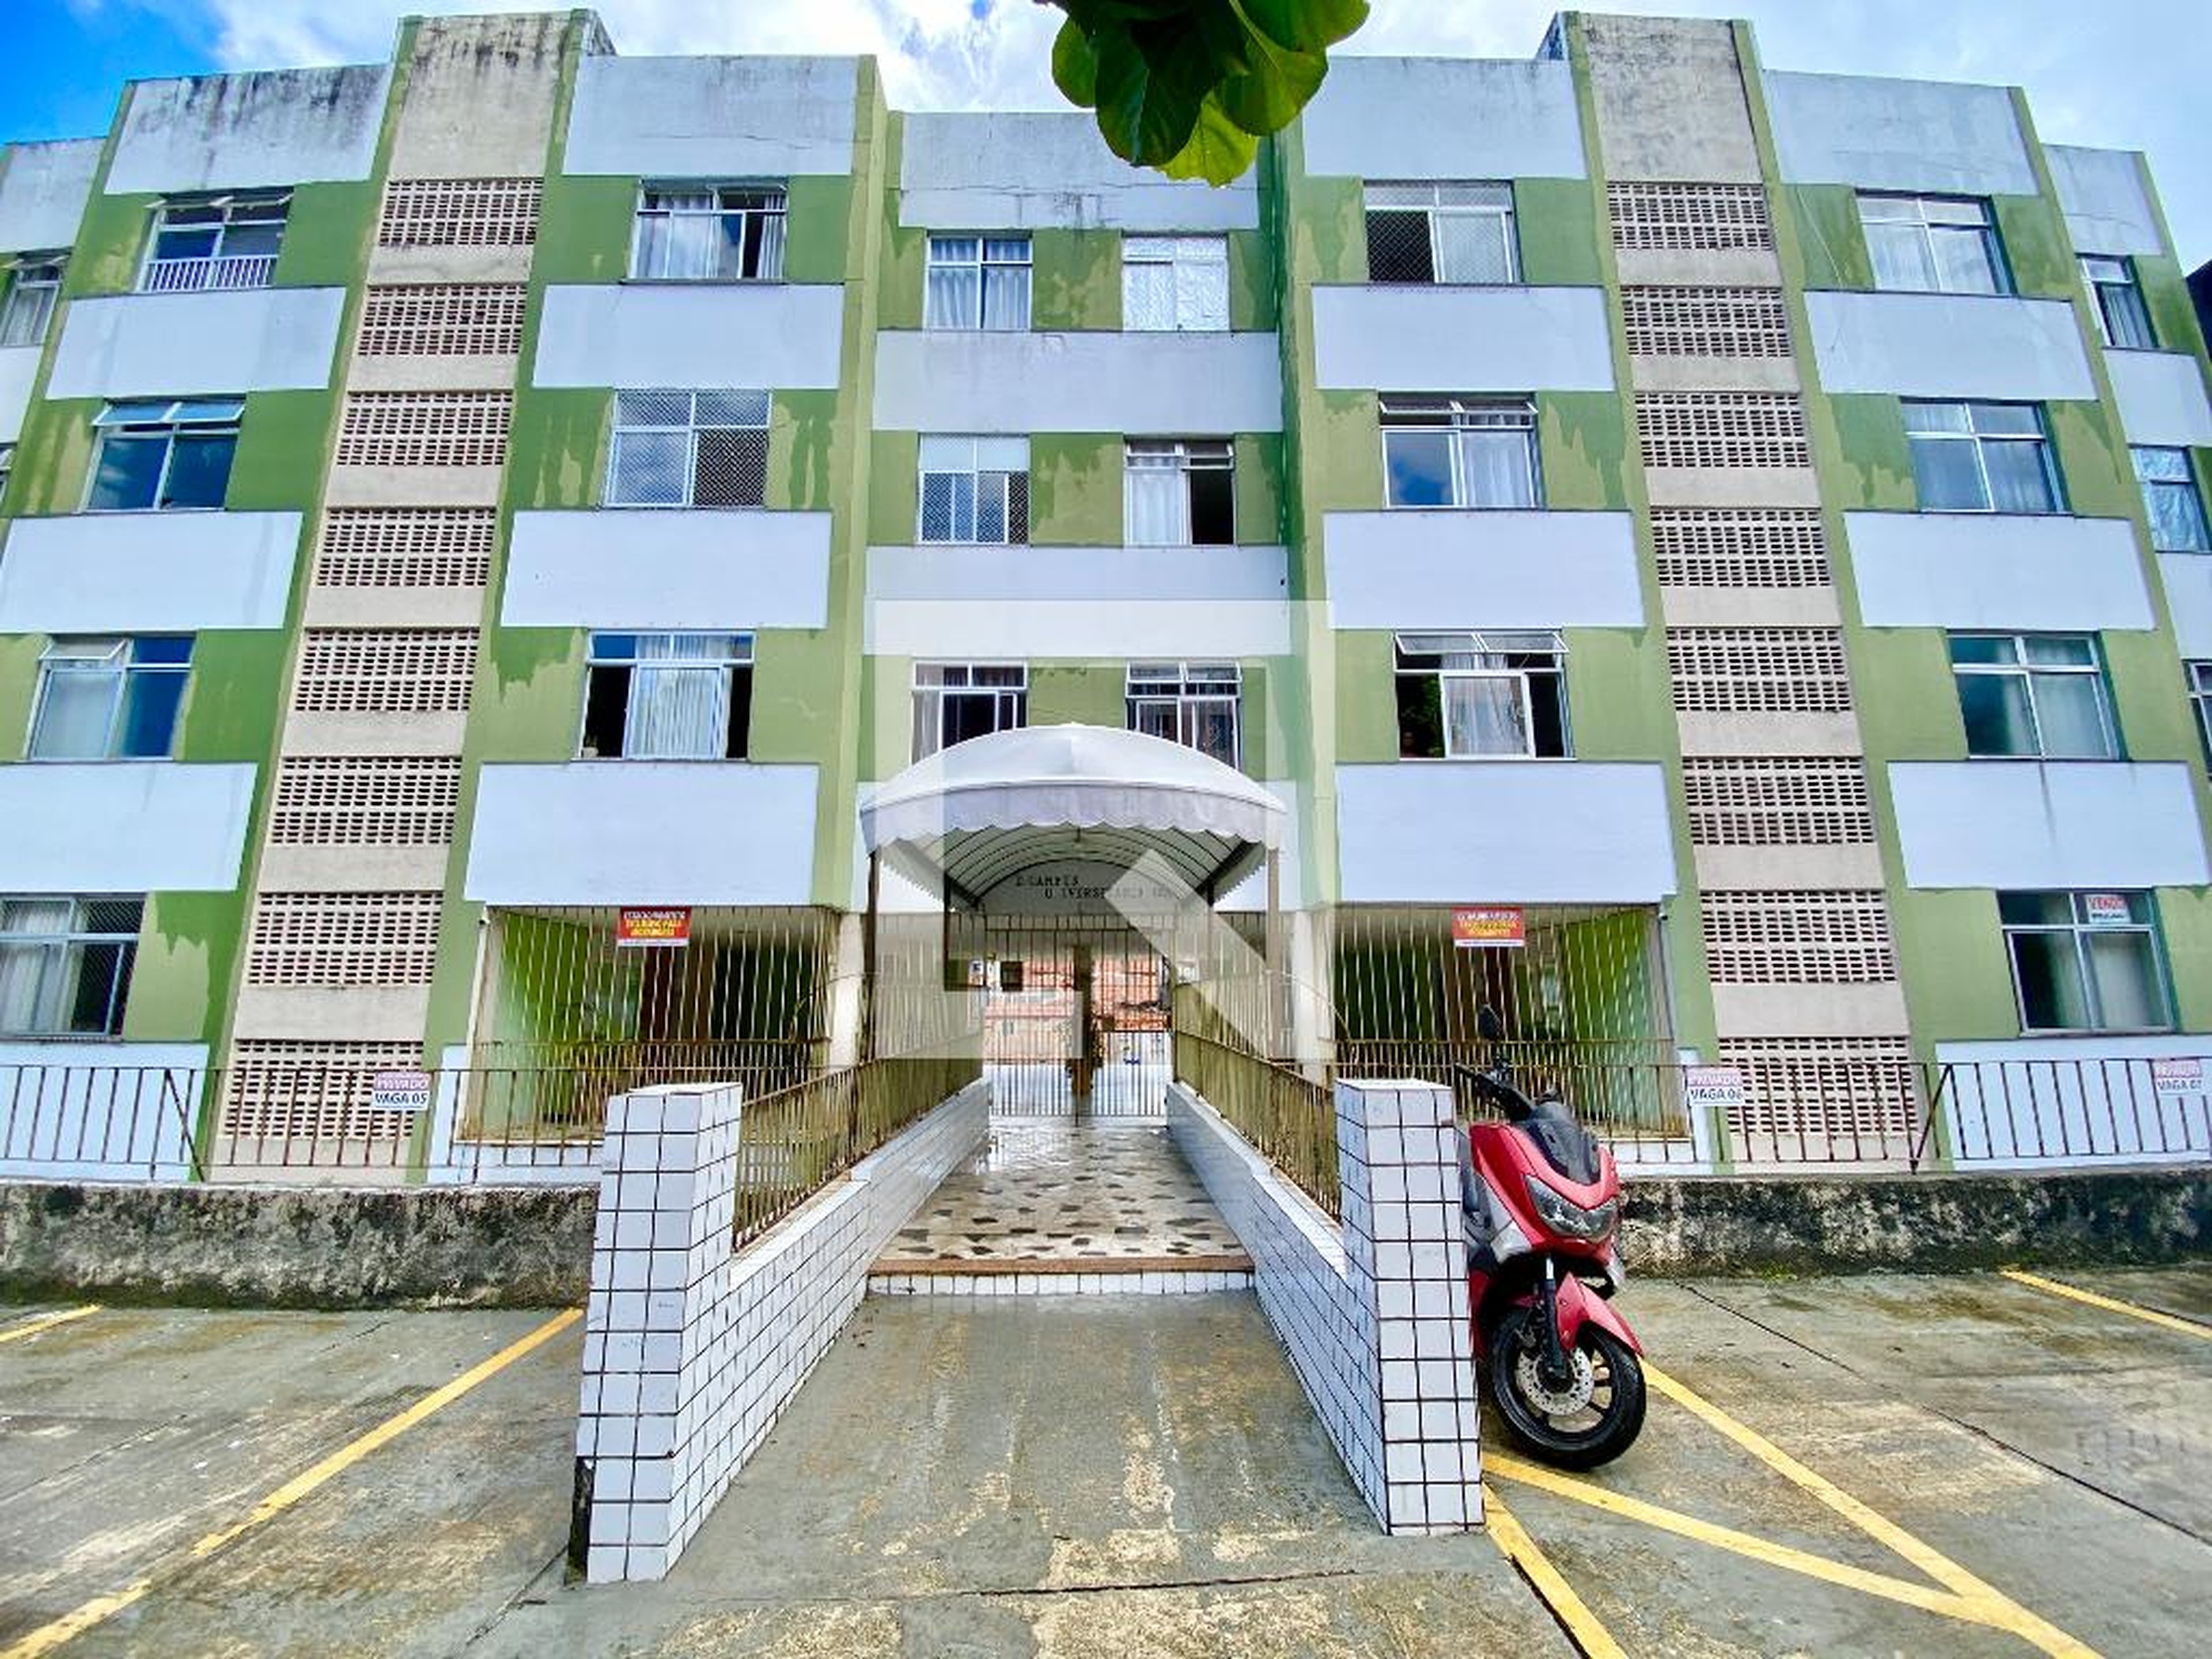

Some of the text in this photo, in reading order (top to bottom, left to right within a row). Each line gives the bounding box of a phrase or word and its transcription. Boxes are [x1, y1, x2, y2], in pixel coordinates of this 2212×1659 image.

[375, 1092, 428, 1104] VAGA 05
[1690, 1088, 1726, 1100] VAGA
